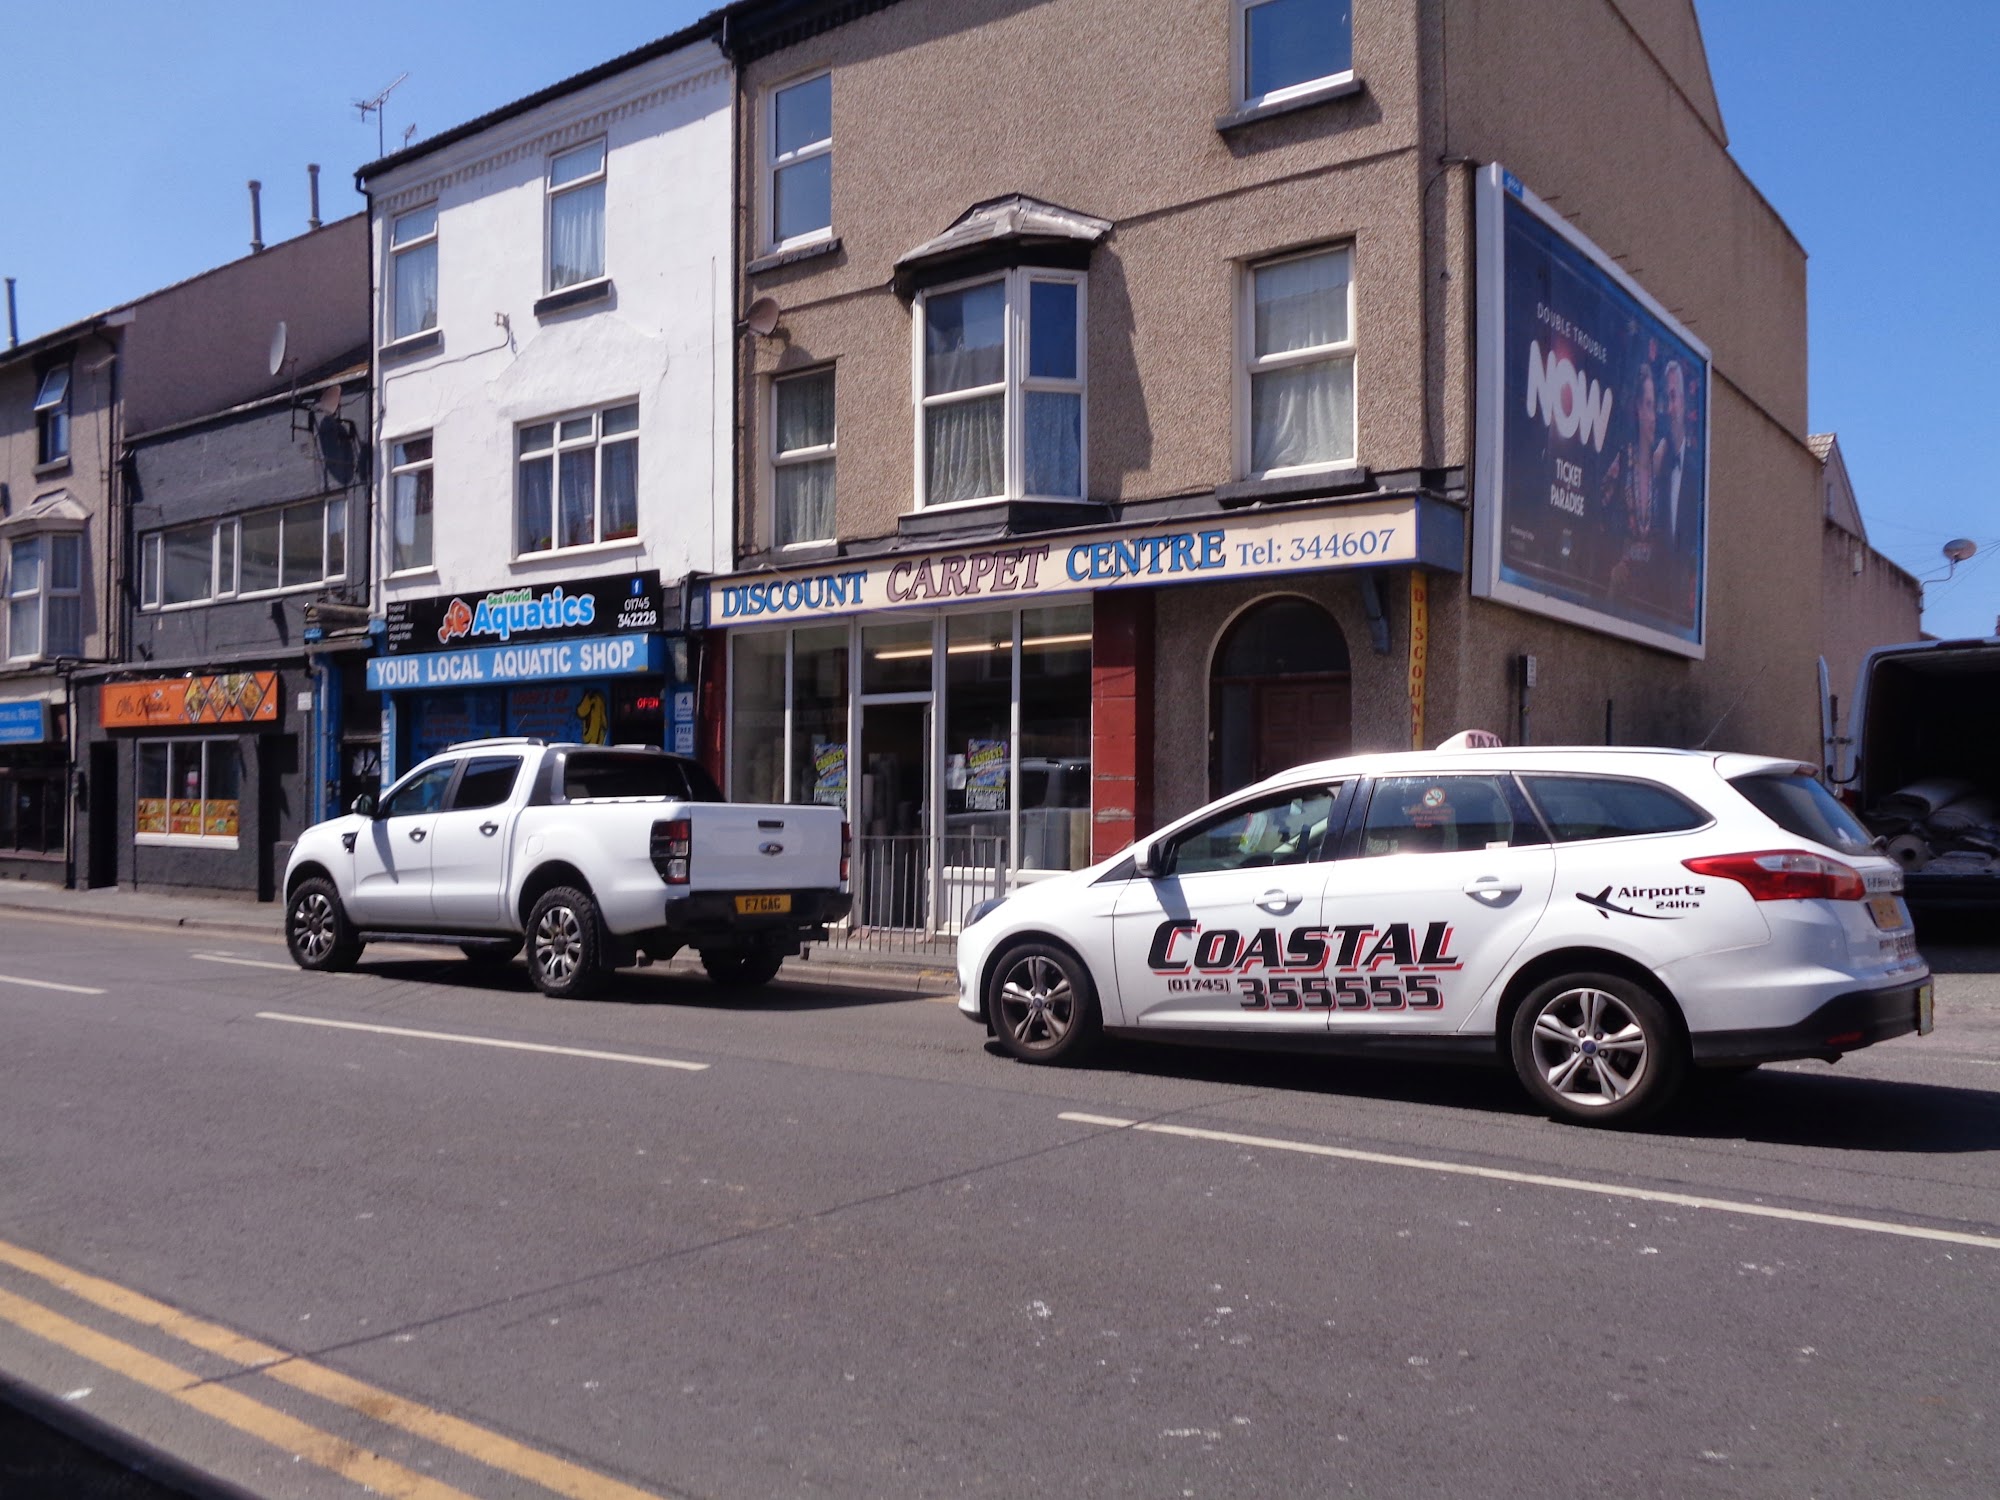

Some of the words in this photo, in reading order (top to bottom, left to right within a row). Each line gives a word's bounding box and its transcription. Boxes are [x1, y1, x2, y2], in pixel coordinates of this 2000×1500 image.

[1537, 302, 1570, 337] DOUBLE
[1573, 326, 1607, 364] TROUBLE
[1527, 339, 1613, 453] NOW
[1556, 458, 1582, 488] TICKET
[1550, 484, 1585, 517] PARADISE
[721, 570, 868, 618] DISCOUNT
[886, 544, 1050, 602] CARPET
[1065, 529, 1226, 582] CENTRE
[1236, 540, 1282, 566] Tel:
[1290, 528, 1395, 561] 344607
[504, 589, 531, 603] World
[624, 597, 650, 611] 01745
[472, 587, 595, 640] Aquatics
[617, 611, 657, 628] 342228
[376, 658, 419, 686] YOUR
[428, 653, 483, 682] LOCAL
[492, 646, 571, 678] AQUATIC
[580, 640, 635, 670] SHOP
[1410, 587, 1425, 736] DISCOUNT
[637, 697, 659, 709] OPEN
[681, 696, 688, 706] 4
[1468, 733, 1501, 748] TAXI
[745, 898, 758, 911] F7
[1618, 885, 1705, 899] Airports
[1656, 900, 1700, 909] 24Hrs
[1147, 919, 1464, 975] COASTAL
[1167, 979, 1231, 994] (01745)
[1237, 975, 1443, 1011] 355555
